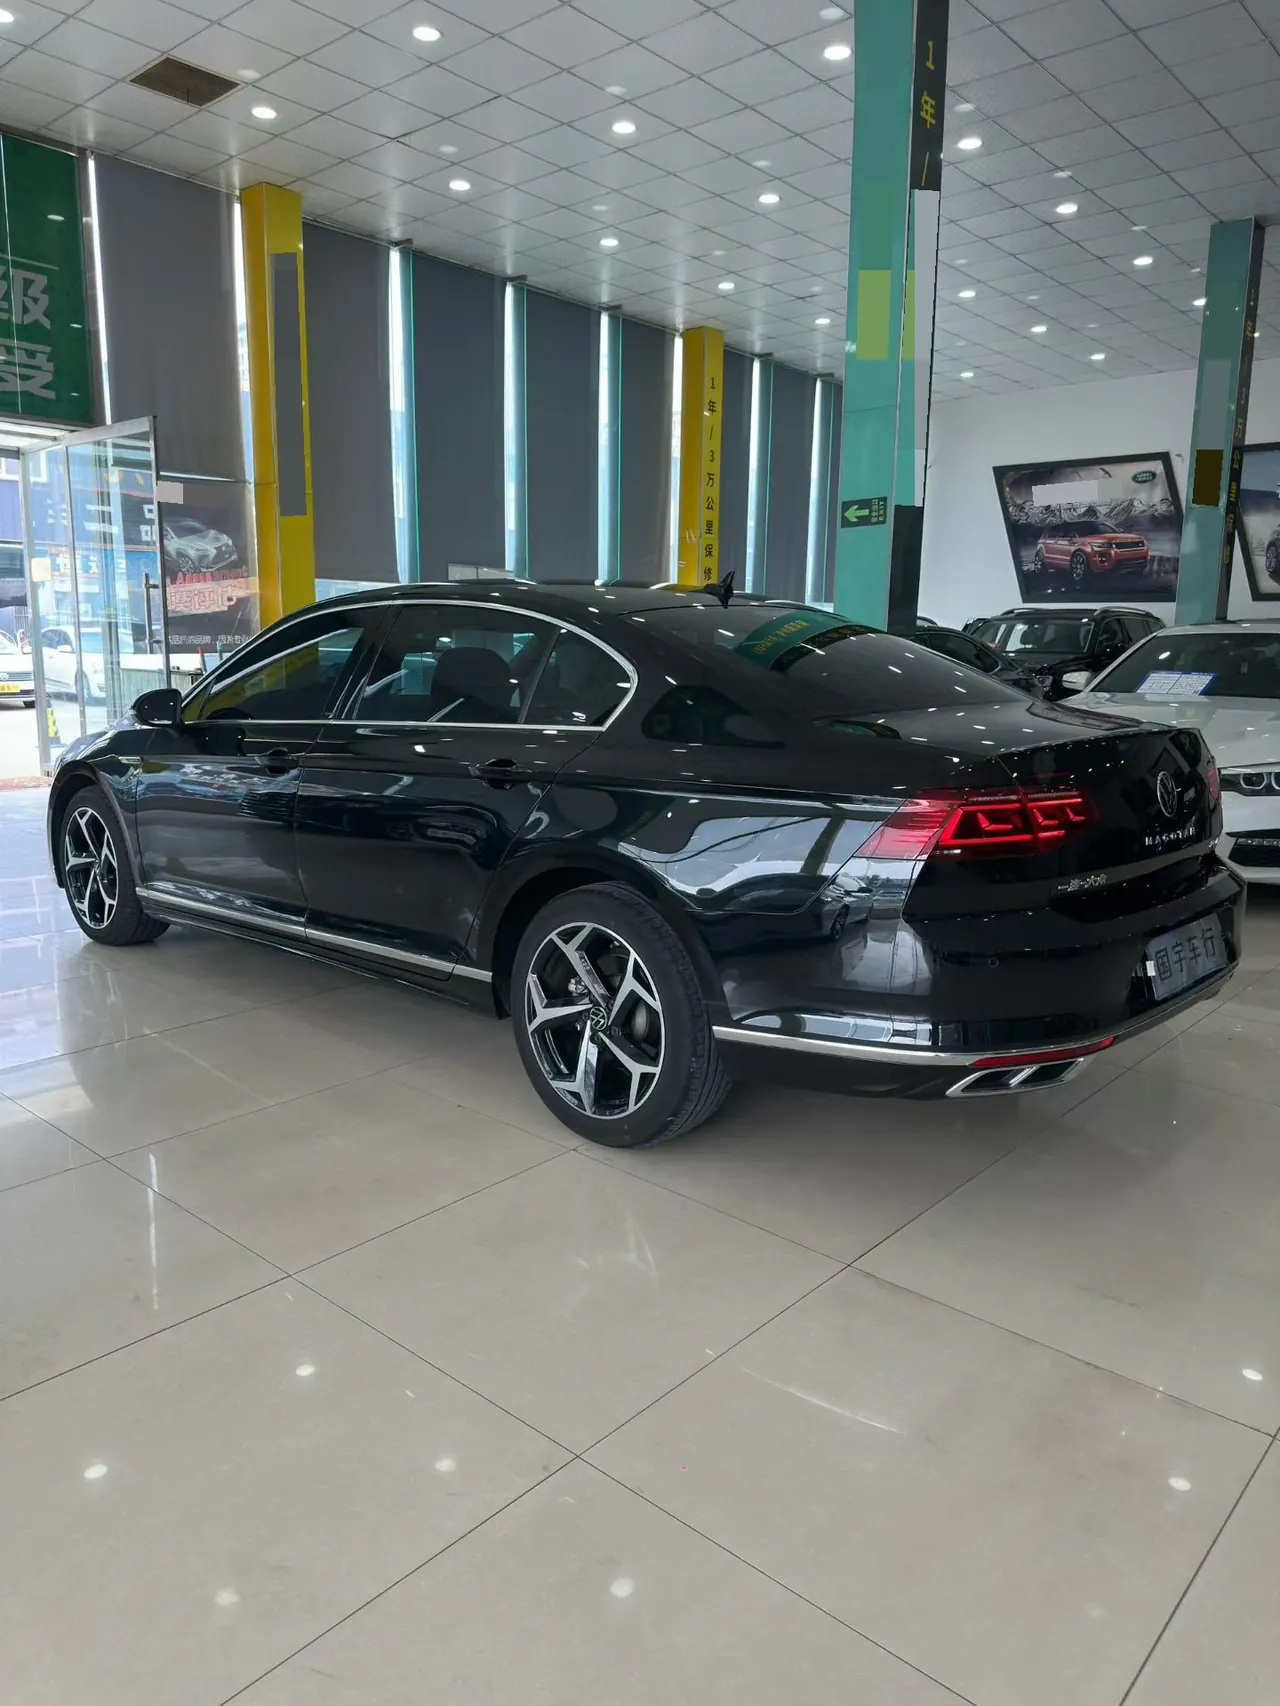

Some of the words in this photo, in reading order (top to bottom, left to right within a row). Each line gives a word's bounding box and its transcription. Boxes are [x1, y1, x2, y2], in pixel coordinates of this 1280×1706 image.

[703, 377, 716, 582] 1年/3万公里保修
